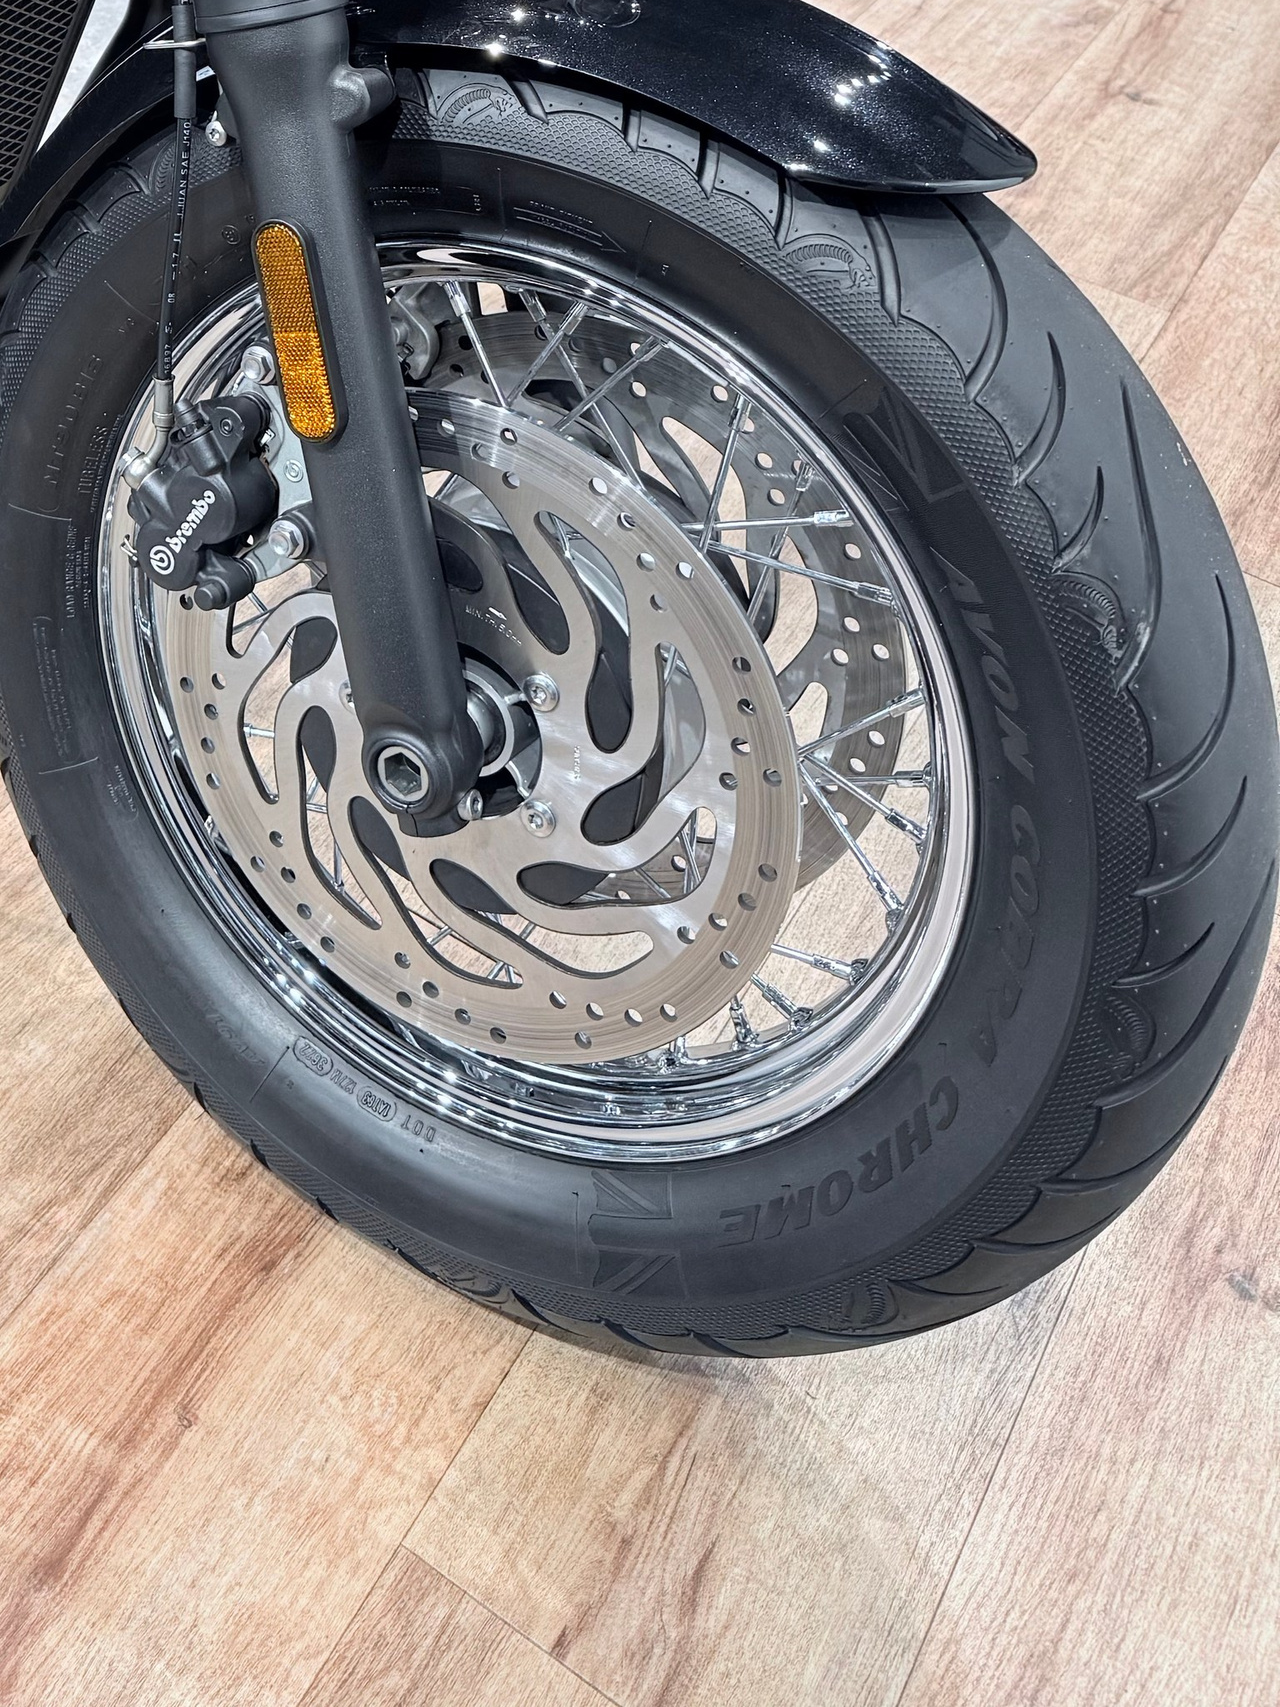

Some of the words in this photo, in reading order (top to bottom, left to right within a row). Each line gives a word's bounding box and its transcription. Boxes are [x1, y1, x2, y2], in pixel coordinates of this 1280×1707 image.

[180, 151, 190, 175] SAE
[75, 424, 110, 495] TUBELESS
[165, 489, 216, 554] brembo
[66, 595, 75, 618] LOAD
[930, 546, 1040, 792] AVON
[982, 805, 1043, 1067] COBRA
[400, 1114, 437, 1143] DOT
[720, 1077, 962, 1248] CHROME
